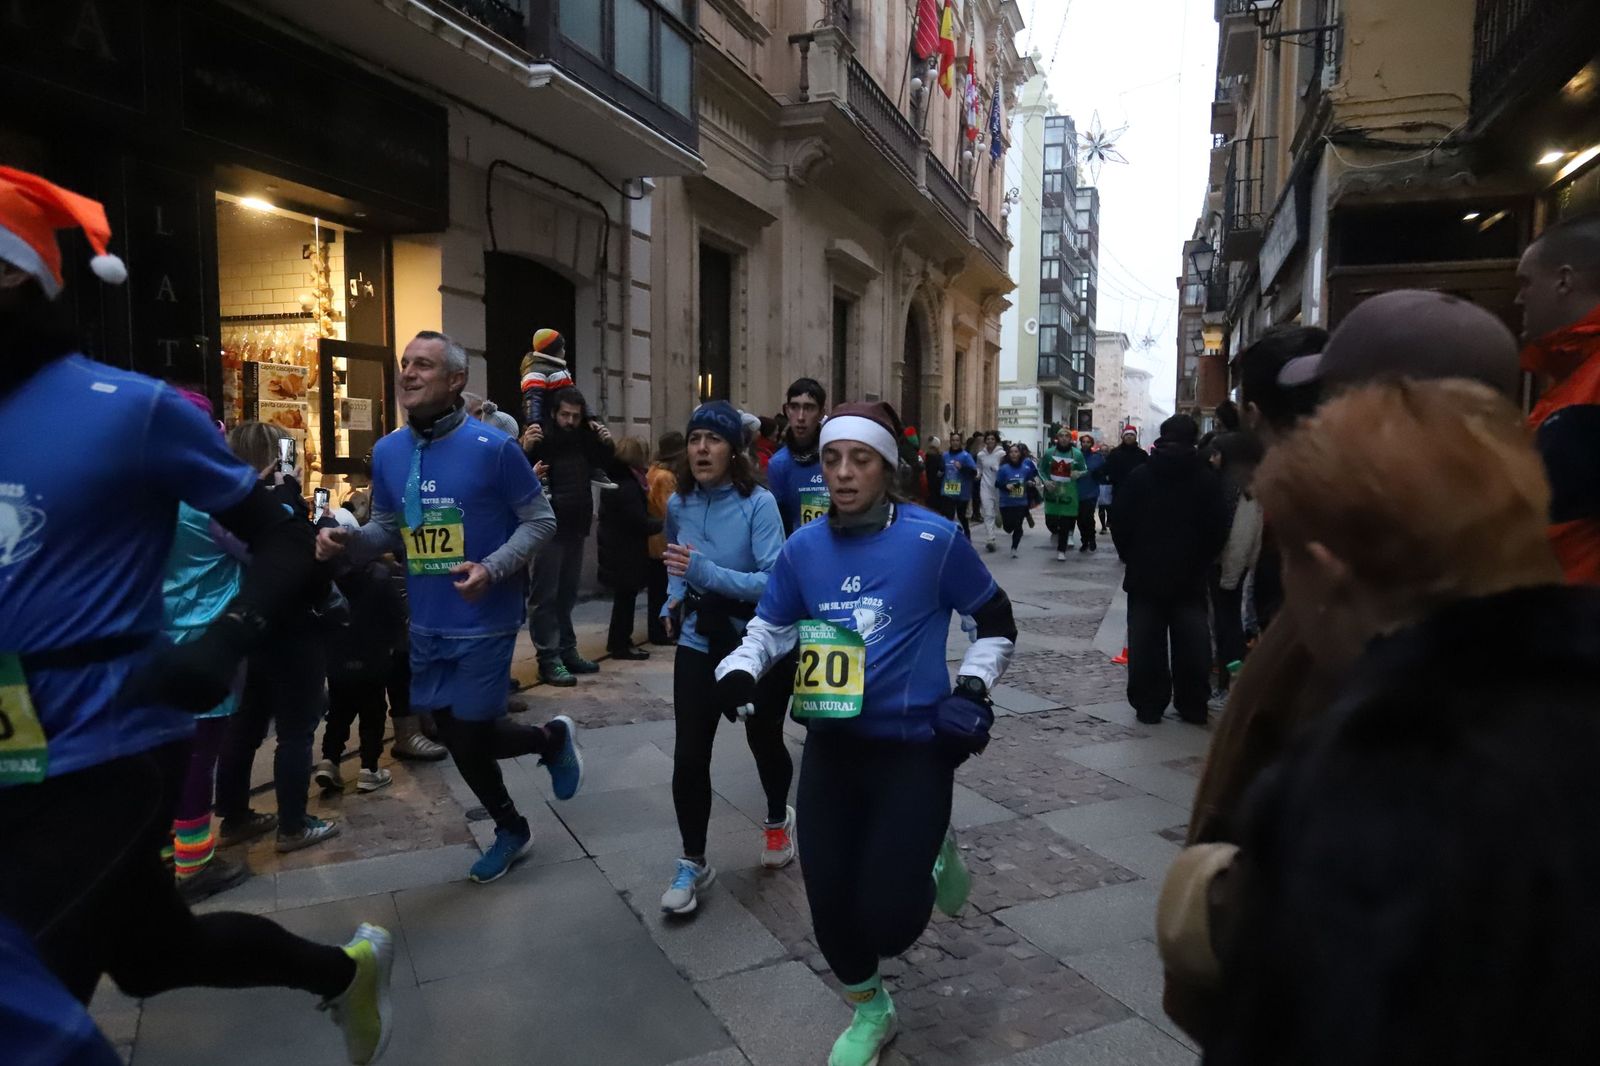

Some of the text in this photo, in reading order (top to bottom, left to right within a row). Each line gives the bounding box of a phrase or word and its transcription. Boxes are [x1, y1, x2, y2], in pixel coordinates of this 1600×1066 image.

[810, 474, 823, 483] 46
[420, 480, 436, 492] 46
[410, 528, 454, 554] 1172
[841, 576, 861, 593] 46
[862, 597, 884, 607] 2025
[803, 701, 857, 712] CAJA RURAL
